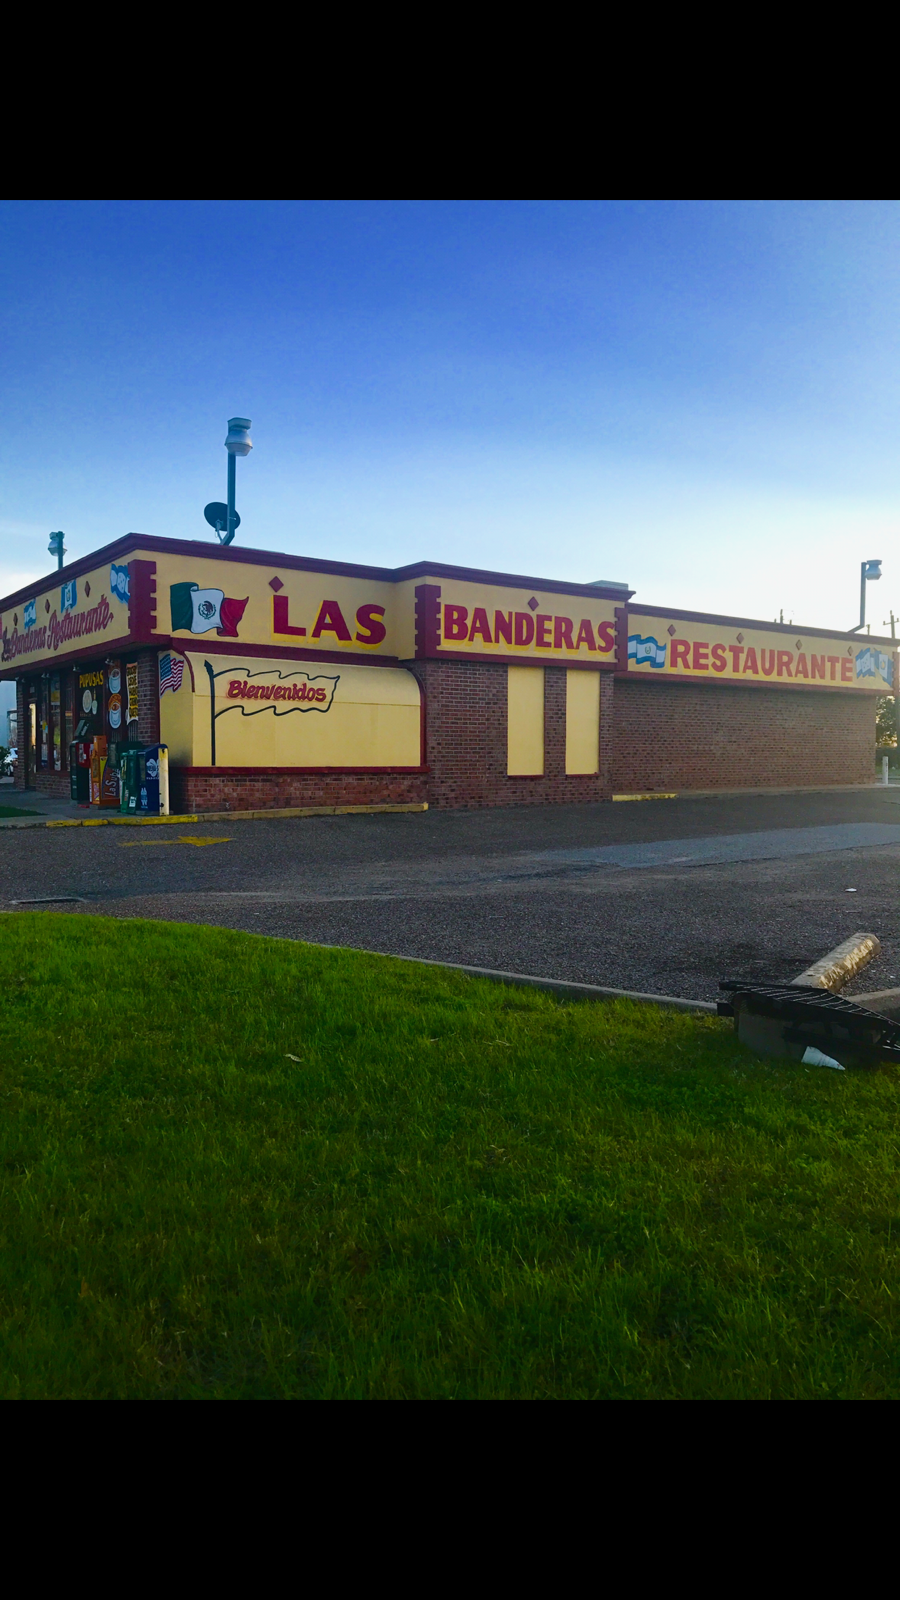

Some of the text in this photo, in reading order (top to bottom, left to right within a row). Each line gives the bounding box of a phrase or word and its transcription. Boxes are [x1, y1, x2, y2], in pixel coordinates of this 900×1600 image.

[11, 625, 47, 657] Banderas
[47, 594, 114, 651] Restaurante
[271, 594, 387, 649] LAS
[442, 603, 615, 657] BANDERAS
[79, 670, 104, 688] PUPUSAS
[669, 638, 854, 685] RESTAURANTE
[226, 680, 327, 703] Bienvenidos
